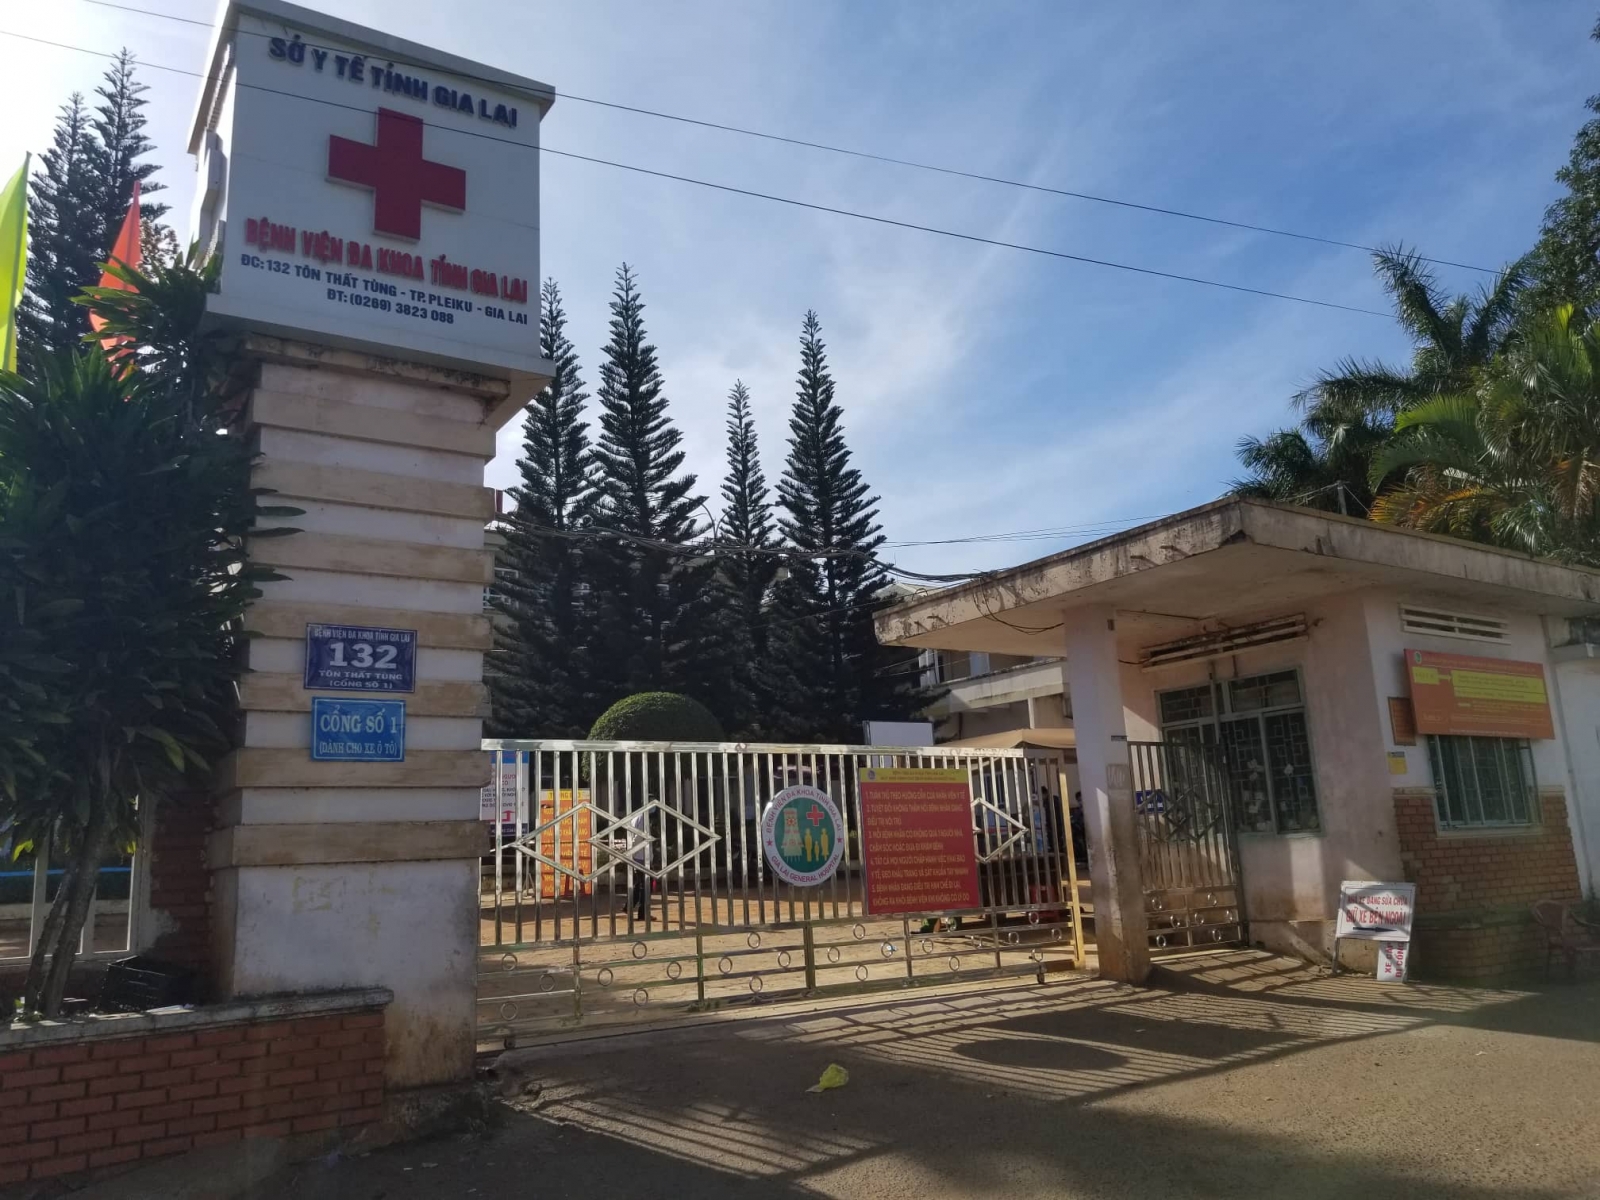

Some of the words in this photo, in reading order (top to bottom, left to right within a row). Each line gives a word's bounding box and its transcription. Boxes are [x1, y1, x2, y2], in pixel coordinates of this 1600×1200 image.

[269, 33, 306, 64] SỞ
[312, 48, 328, 71] Y
[335, 54, 368, 82] TẾ
[370, 61, 428, 101] TỈNH
[433, 85, 475, 114] GIA
[245, 216, 296, 254] BỆNH
[302, 230, 343, 264] VIỆN
[347, 240, 373, 270] ĐA
[377, 247, 424, 280] KHOA
[431, 254, 468, 291] TỈNH
[471, 268, 499, 297] GIA
[501, 275, 527, 304] LAI
[294, 264, 321, 281] TÔN
[325, 271, 359, 289] THẤT
[362, 278, 397, 297] TÙNG
[485, 305, 505, 320] GIA
[508, 310, 527, 325] LAI
[395, 302, 428, 319] 3823
[431, 310, 454, 324] 088
[401, 633, 410, 643] LAI
[329, 641, 398, 669] 132
[320, 704, 361, 733] CỔNG
[365, 708, 385, 734] SỐ
[390, 716, 398, 734] 1
[364, 742, 376, 754] XE
[796, 788, 815, 798] KHOA
[789, 872, 818, 883] GENERAL
[818, 853, 840, 879] HOSPITAL
[1359, 909, 1367, 924] XE
